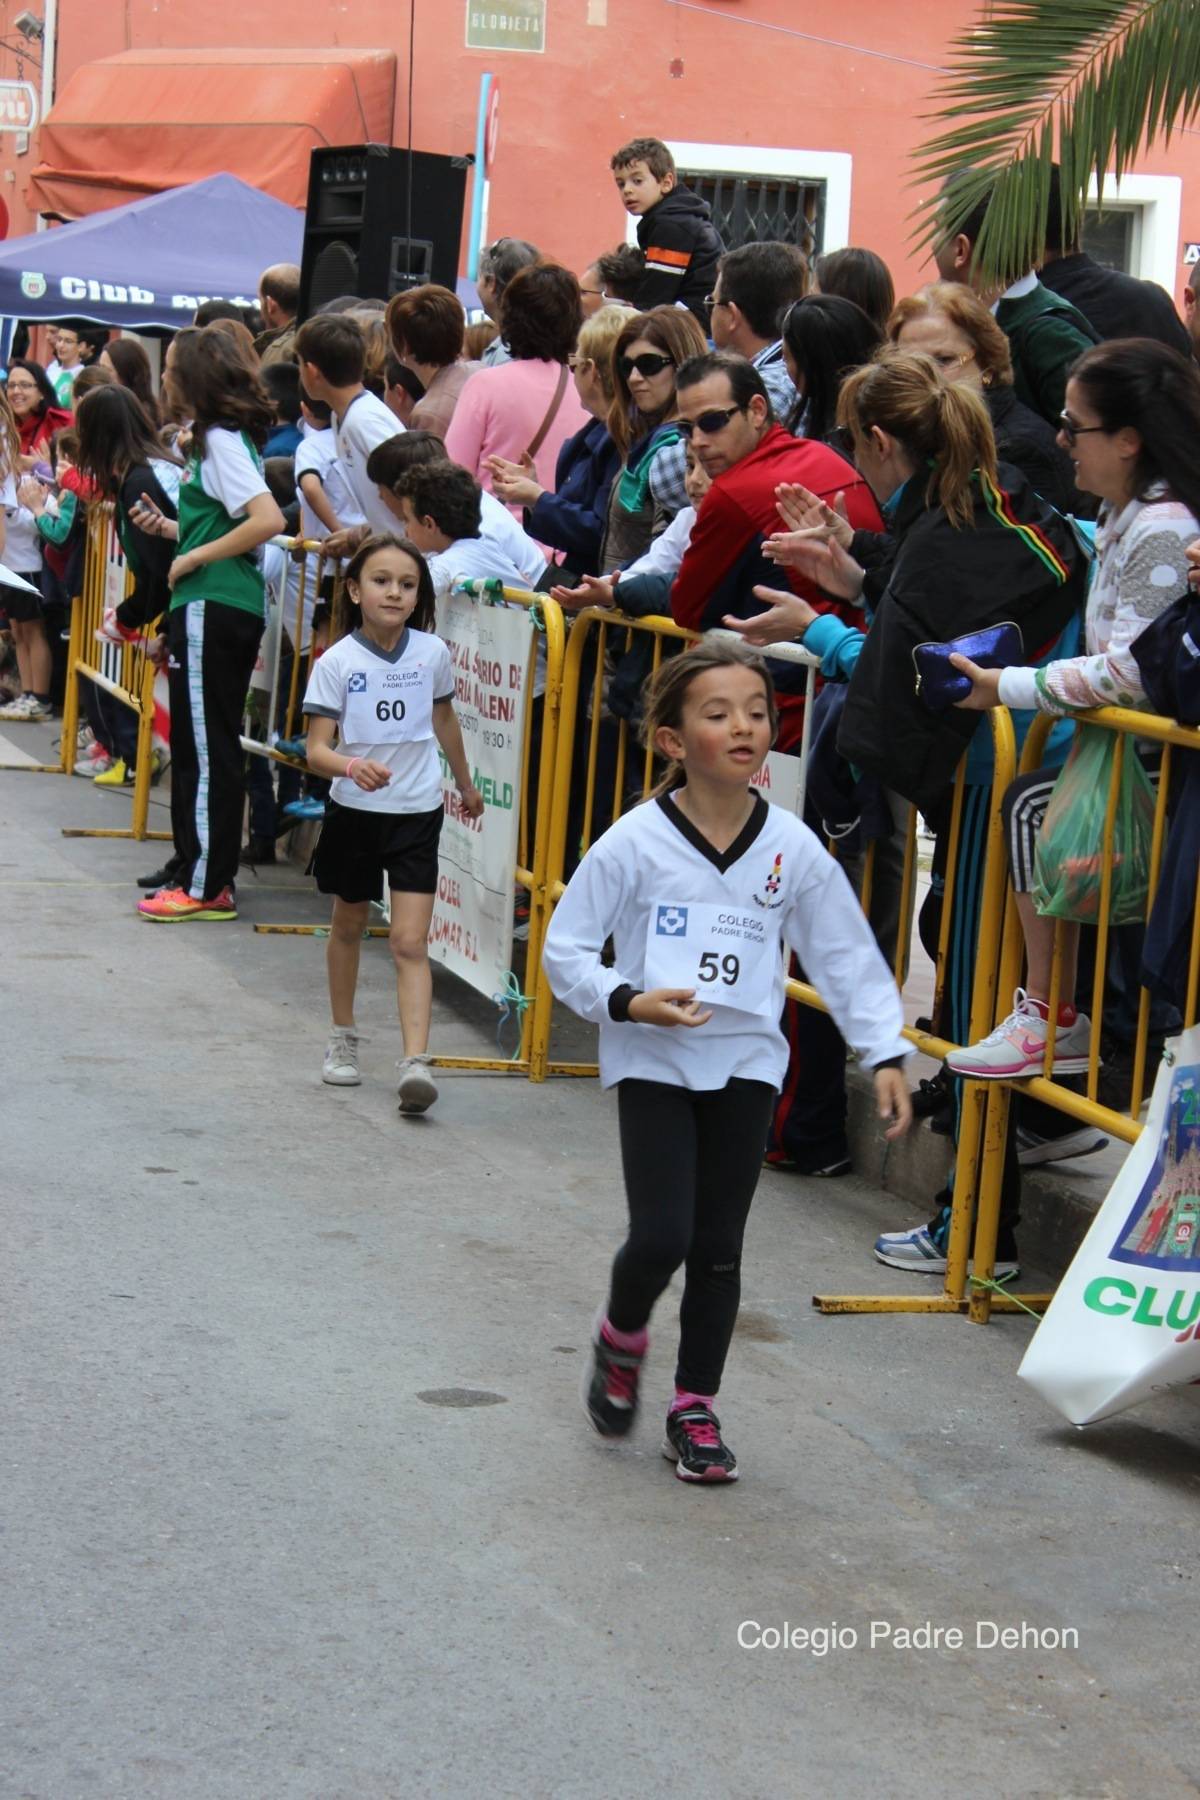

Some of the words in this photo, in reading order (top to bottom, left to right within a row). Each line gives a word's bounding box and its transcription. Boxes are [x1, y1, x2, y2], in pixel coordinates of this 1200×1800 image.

[471, 12, 540, 33] GLORIETA
[60, 276, 155, 305] Club
[386, 671, 418, 681] COLEGIO
[376, 700, 406, 722] 60
[711, 926, 742, 938] PADRE
[718, 914, 764, 932] COLEGIO
[698, 952, 740, 986] 59
